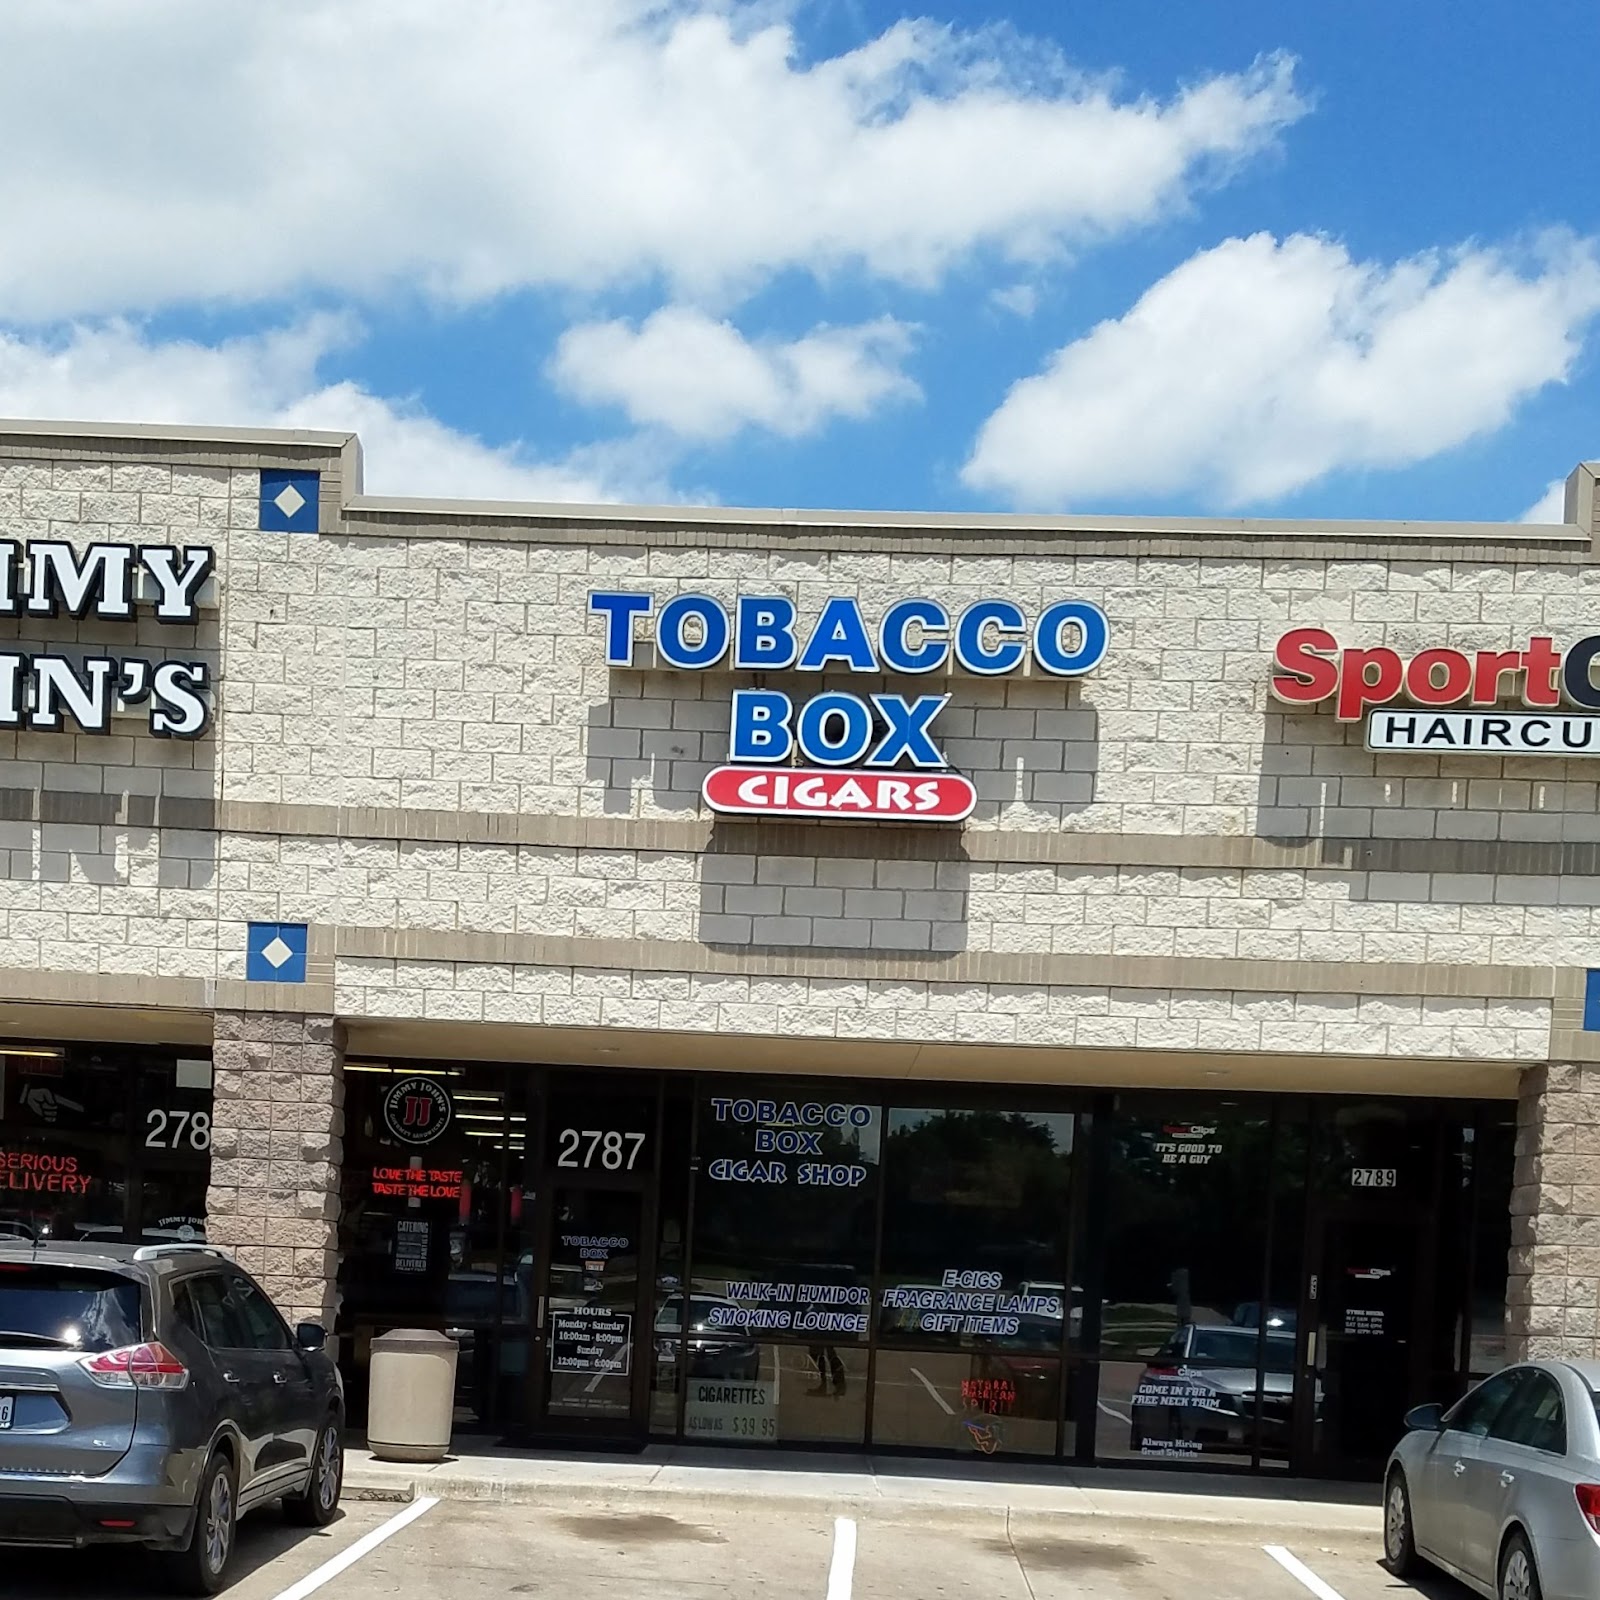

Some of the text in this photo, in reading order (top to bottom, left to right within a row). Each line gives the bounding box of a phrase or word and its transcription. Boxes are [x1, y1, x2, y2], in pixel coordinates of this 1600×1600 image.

[588, 591, 1111, 676] TOBACCO
[729, 689, 952, 768] BOX
[1386, 717, 1592, 748] HAIRCU
[738, 775, 941, 812] CIGARS
[389, 1082, 417, 1109] JIMMY
[403, 1096, 433, 1126] JJ
[711, 1098, 872, 1127] TOBACCO
[558, 1129, 645, 1170] 2787
[755, 1129, 823, 1155] BOX
[1177, 1143, 1206, 1153] GOOD
[1207, 1144, 1223, 1154] TO
[0, 1151, 78, 1173] SERIOUS
[1178, 1154, 1187, 1164] A
[1188, 1155, 1212, 1164] GUY
[372, 1166, 463, 1183] LOVE THE TASTE
[708, 1158, 867, 1187] CIGAR SHOP
[1354, 1169, 1395, 1186] 2789
[371, 1182, 461, 1198] TASTE THE LOVE
[561, 1235, 629, 1248] TOBACCO
[579, 1248, 609, 1259] BOX
[942, 1269, 1002, 1290] E-CIGS
[726, 1281, 870, 1305] WALK-IN HUMIDOR
[882, 1289, 1060, 1314] FRAGRANCE LAMPS
[573, 1307, 612, 1316] HOURS
[708, 1307, 869, 1333] SMOKING LOUNGE
[558, 1319, 587, 1330] Monday
[592, 1321, 625, 1332] Saturday
[920, 1313, 1020, 1335] GIFT ITEMS
[576, 1345, 605, 1357] Sunday
[699, 1386, 765, 1405] CIGARETTES
[1139, 1384, 1169, 1394] COME
[1170, 1386, 1183, 1395] IN
[1184, 1387, 1207, 1396] FOR
[1131, 1394, 1221, 1408] FREE NECK TRIM
[1141, 1438, 1173, 1449] Always
